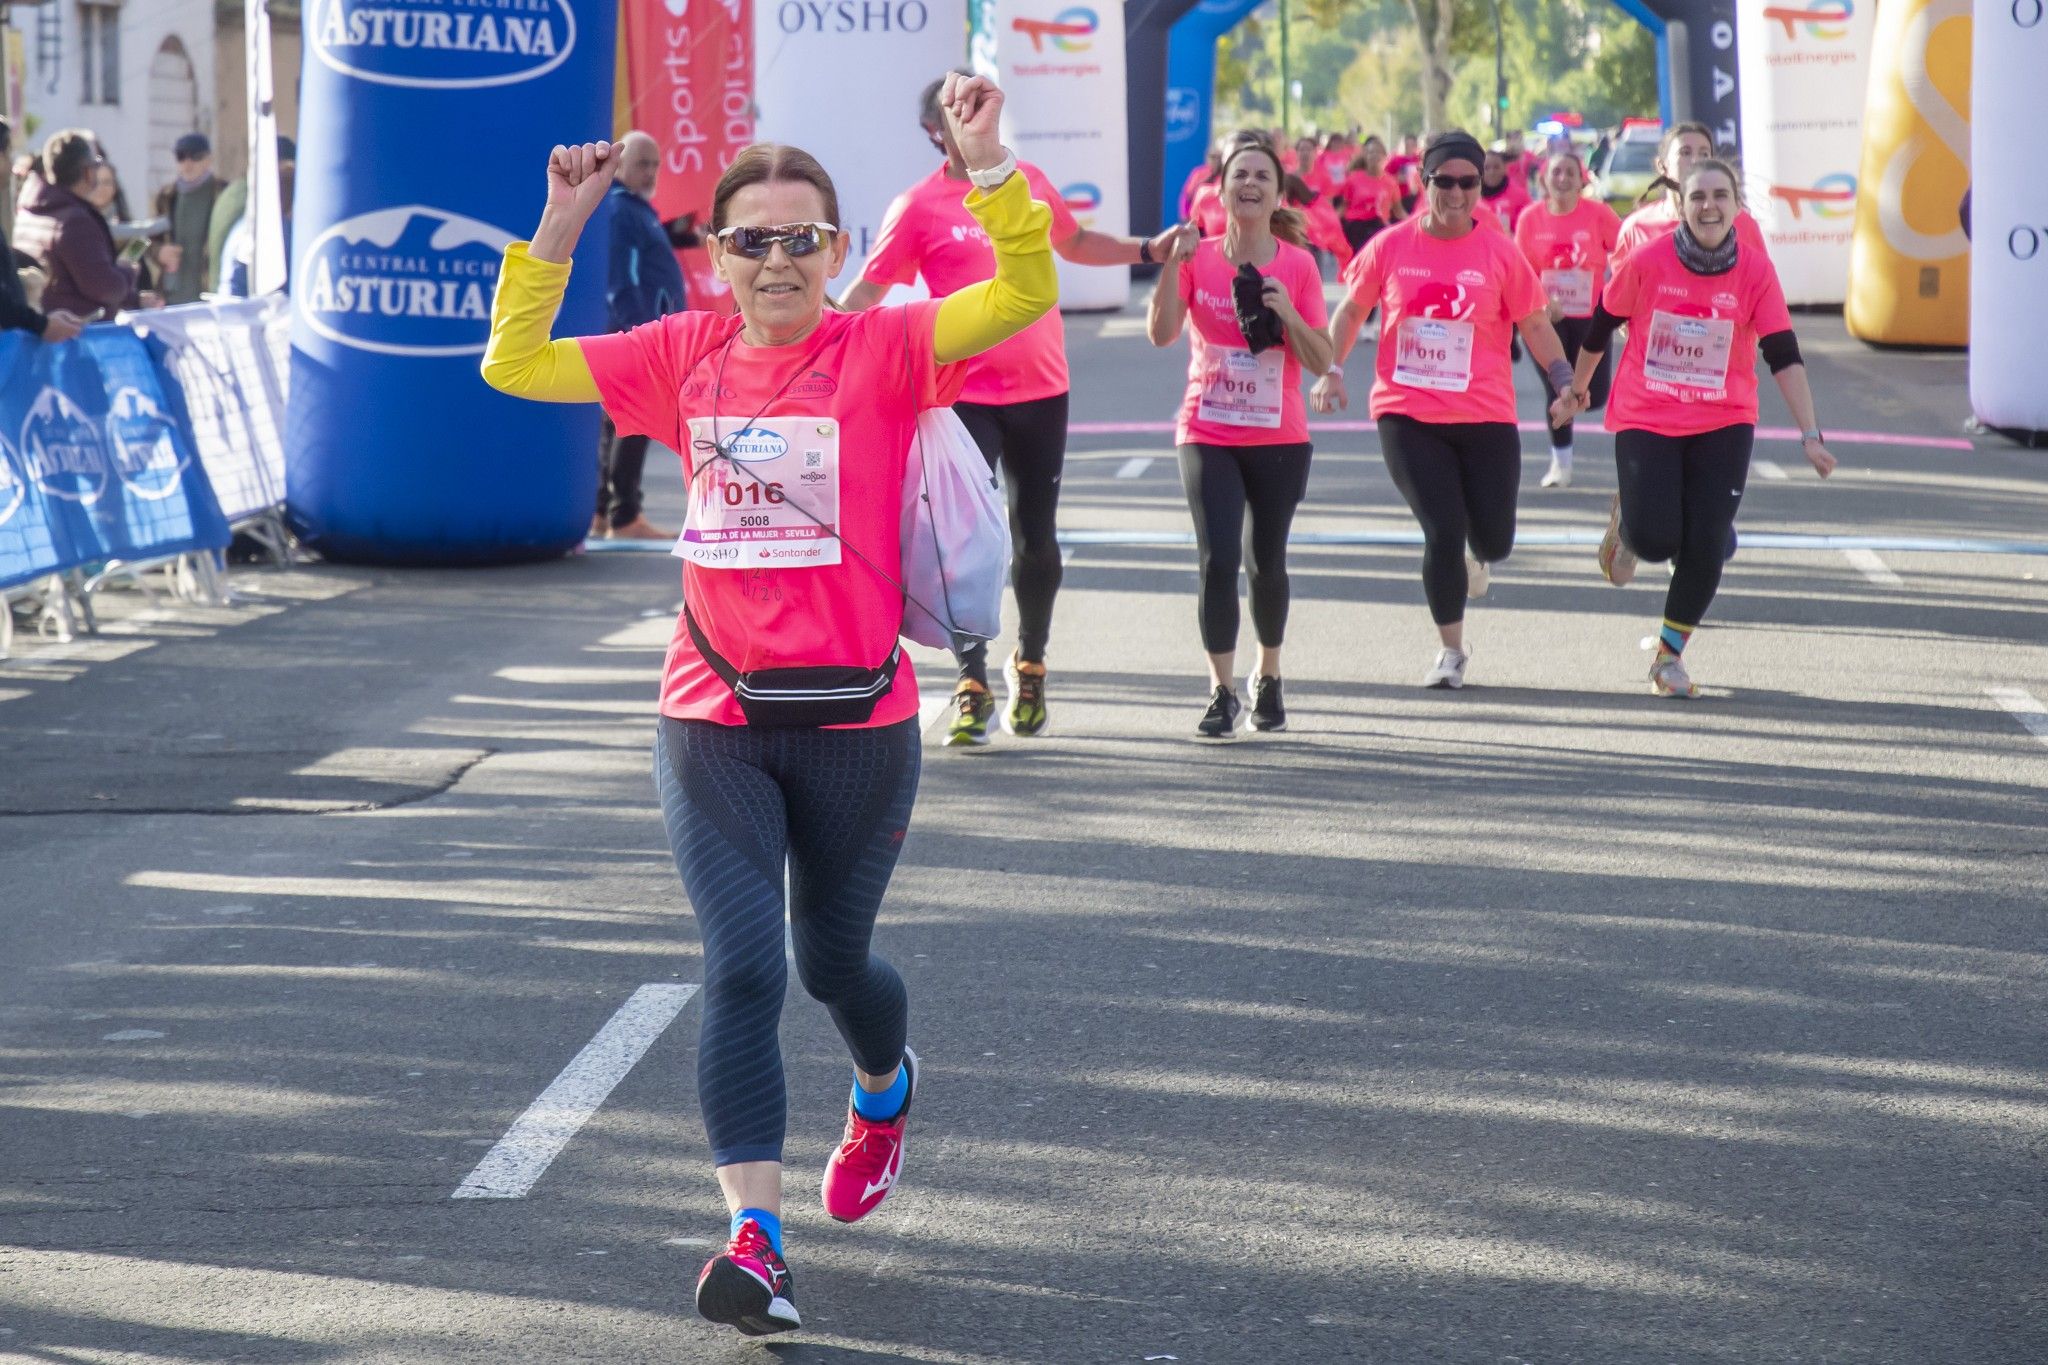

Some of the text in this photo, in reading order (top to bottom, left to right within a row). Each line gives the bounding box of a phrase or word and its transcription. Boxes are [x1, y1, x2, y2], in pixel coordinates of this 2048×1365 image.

[779, 0, 928, 33] OYSHO
[320, 0, 557, 56] ASTURIANA
[1711, 20, 1738, 147] LVO
[664, 25, 707, 174] Sports
[1769, 231, 1852, 244] TotalEnergi
[339, 255, 496, 276] CENTRAL LECH
[1398, 267, 1431, 277] OYSHO
[1418, 348, 1446, 361] 016
[1674, 345, 1704, 358] 016
[1225, 380, 1256, 394] 016
[724, 440, 783, 453] STURIANA
[723, 482, 785, 506] 016
[740, 515, 770, 527] 5008
[729, 531, 739, 540] DE
[740, 531, 751, 539] LA
[752, 530, 778, 539] MUJER
[785, 528, 816, 538] SEVILLA
[693, 547, 821, 560] OYSHO Santander
